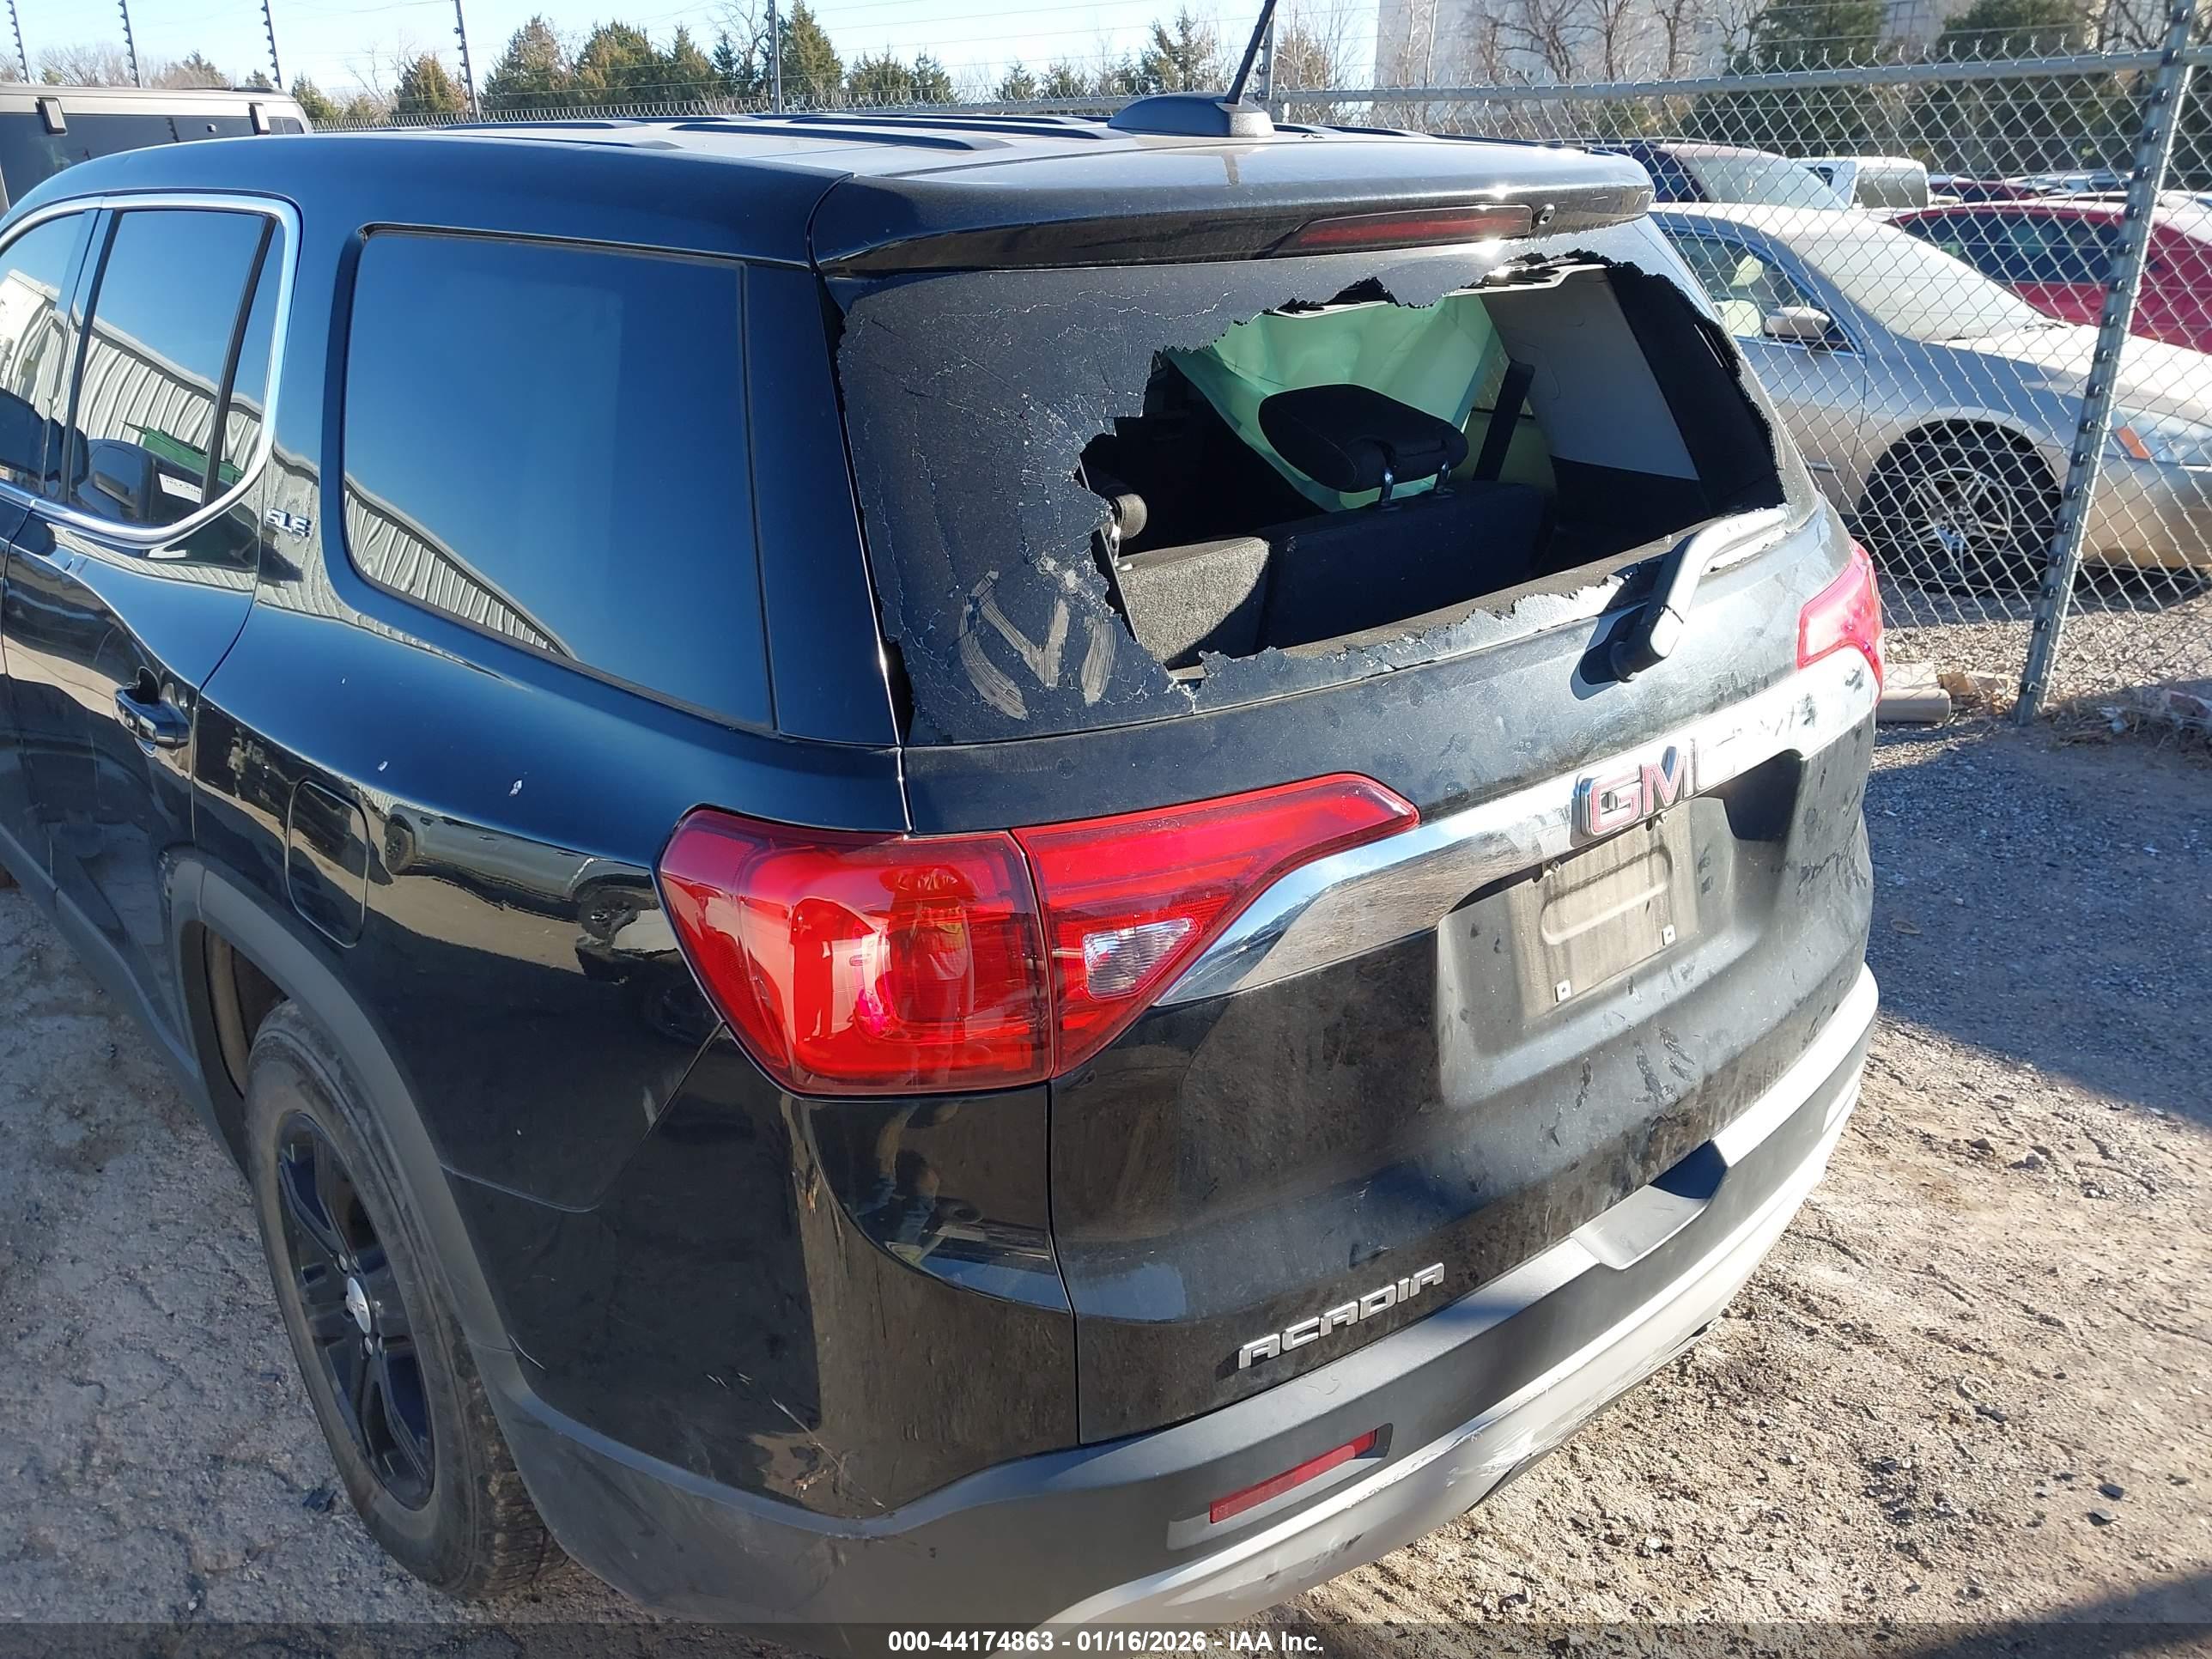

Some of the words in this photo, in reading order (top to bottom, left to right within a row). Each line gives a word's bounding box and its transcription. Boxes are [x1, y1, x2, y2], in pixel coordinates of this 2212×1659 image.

[265, 507, 312, 538] SLE
[1582, 728, 1736, 836] GMC
[1237, 1262, 1444, 1370] ACADIA
